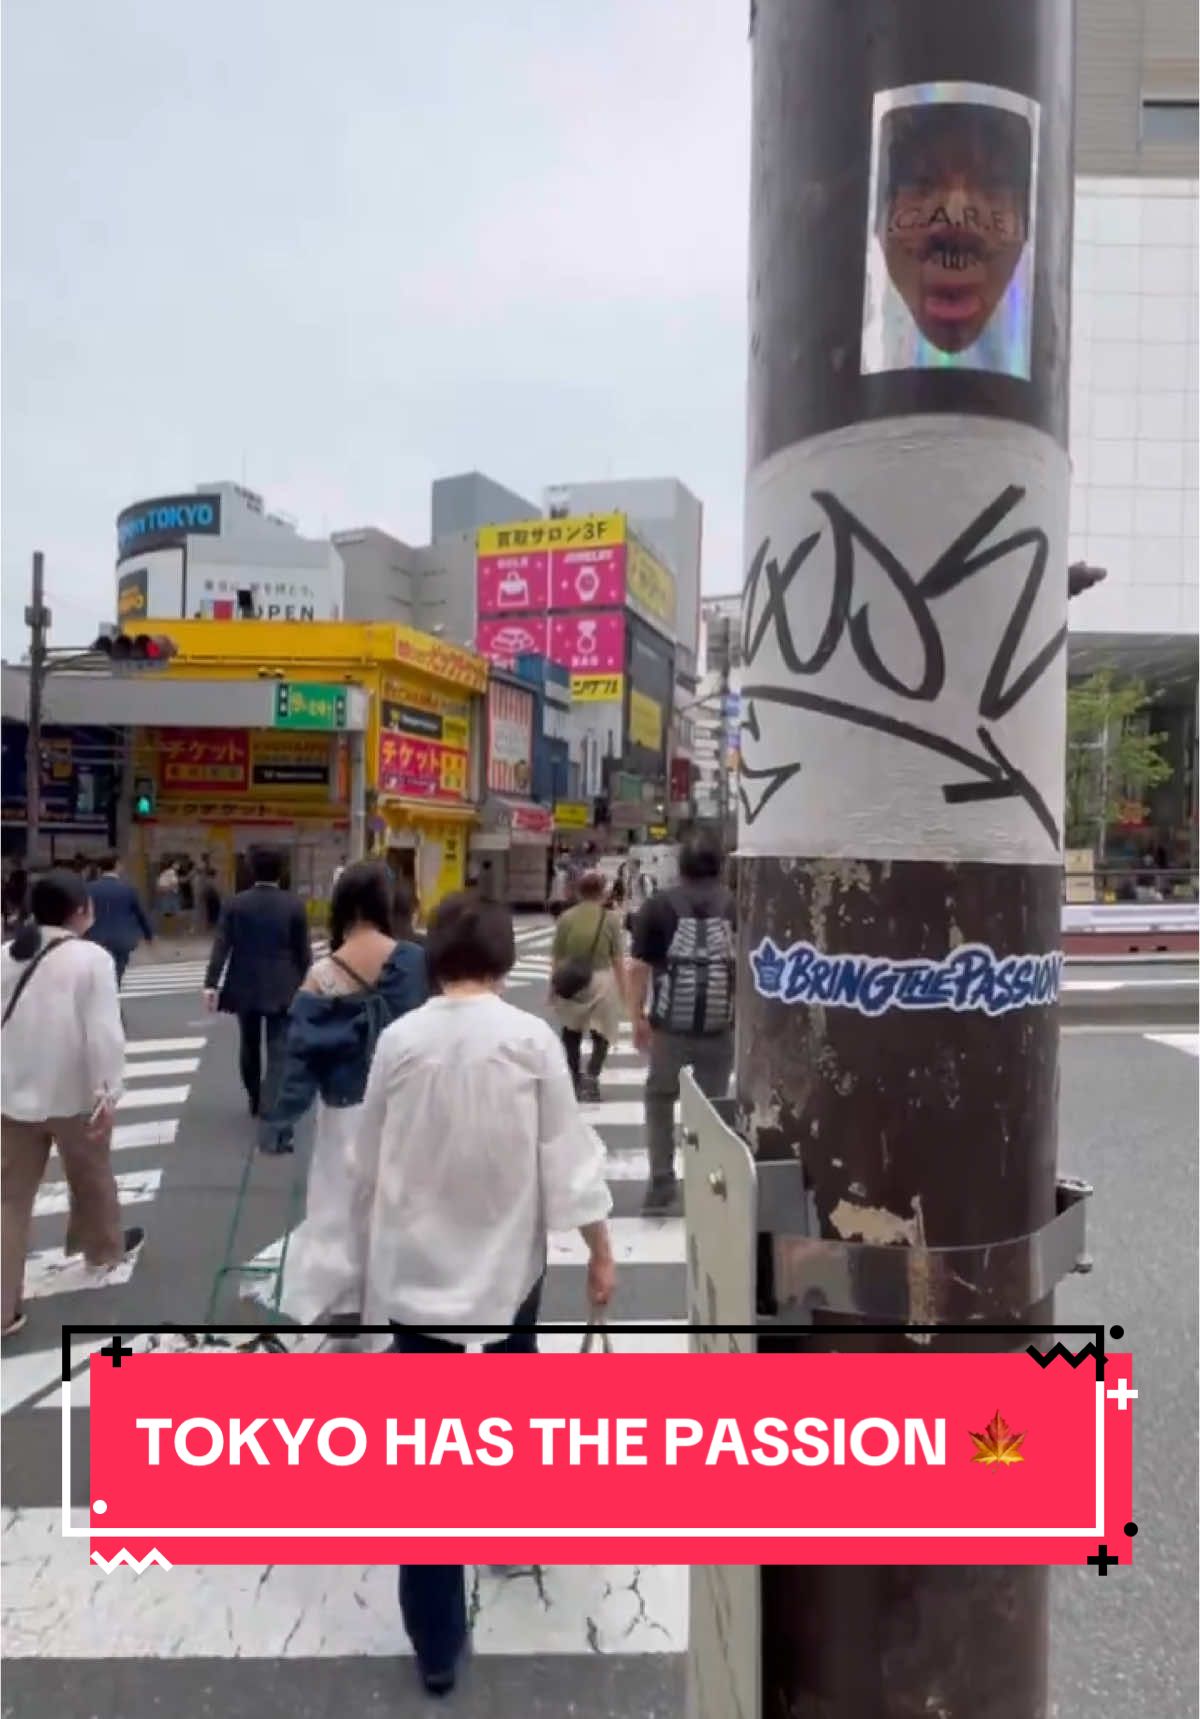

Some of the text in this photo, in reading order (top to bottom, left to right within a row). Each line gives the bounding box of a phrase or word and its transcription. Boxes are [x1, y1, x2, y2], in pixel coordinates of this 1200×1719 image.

[147, 504, 214, 530] TOKYO
[497, 522, 609, 547] 買取サロン3F
[382, 739, 440, 775] チケット
[785, 946, 1062, 1010] BRING THE PASSION
